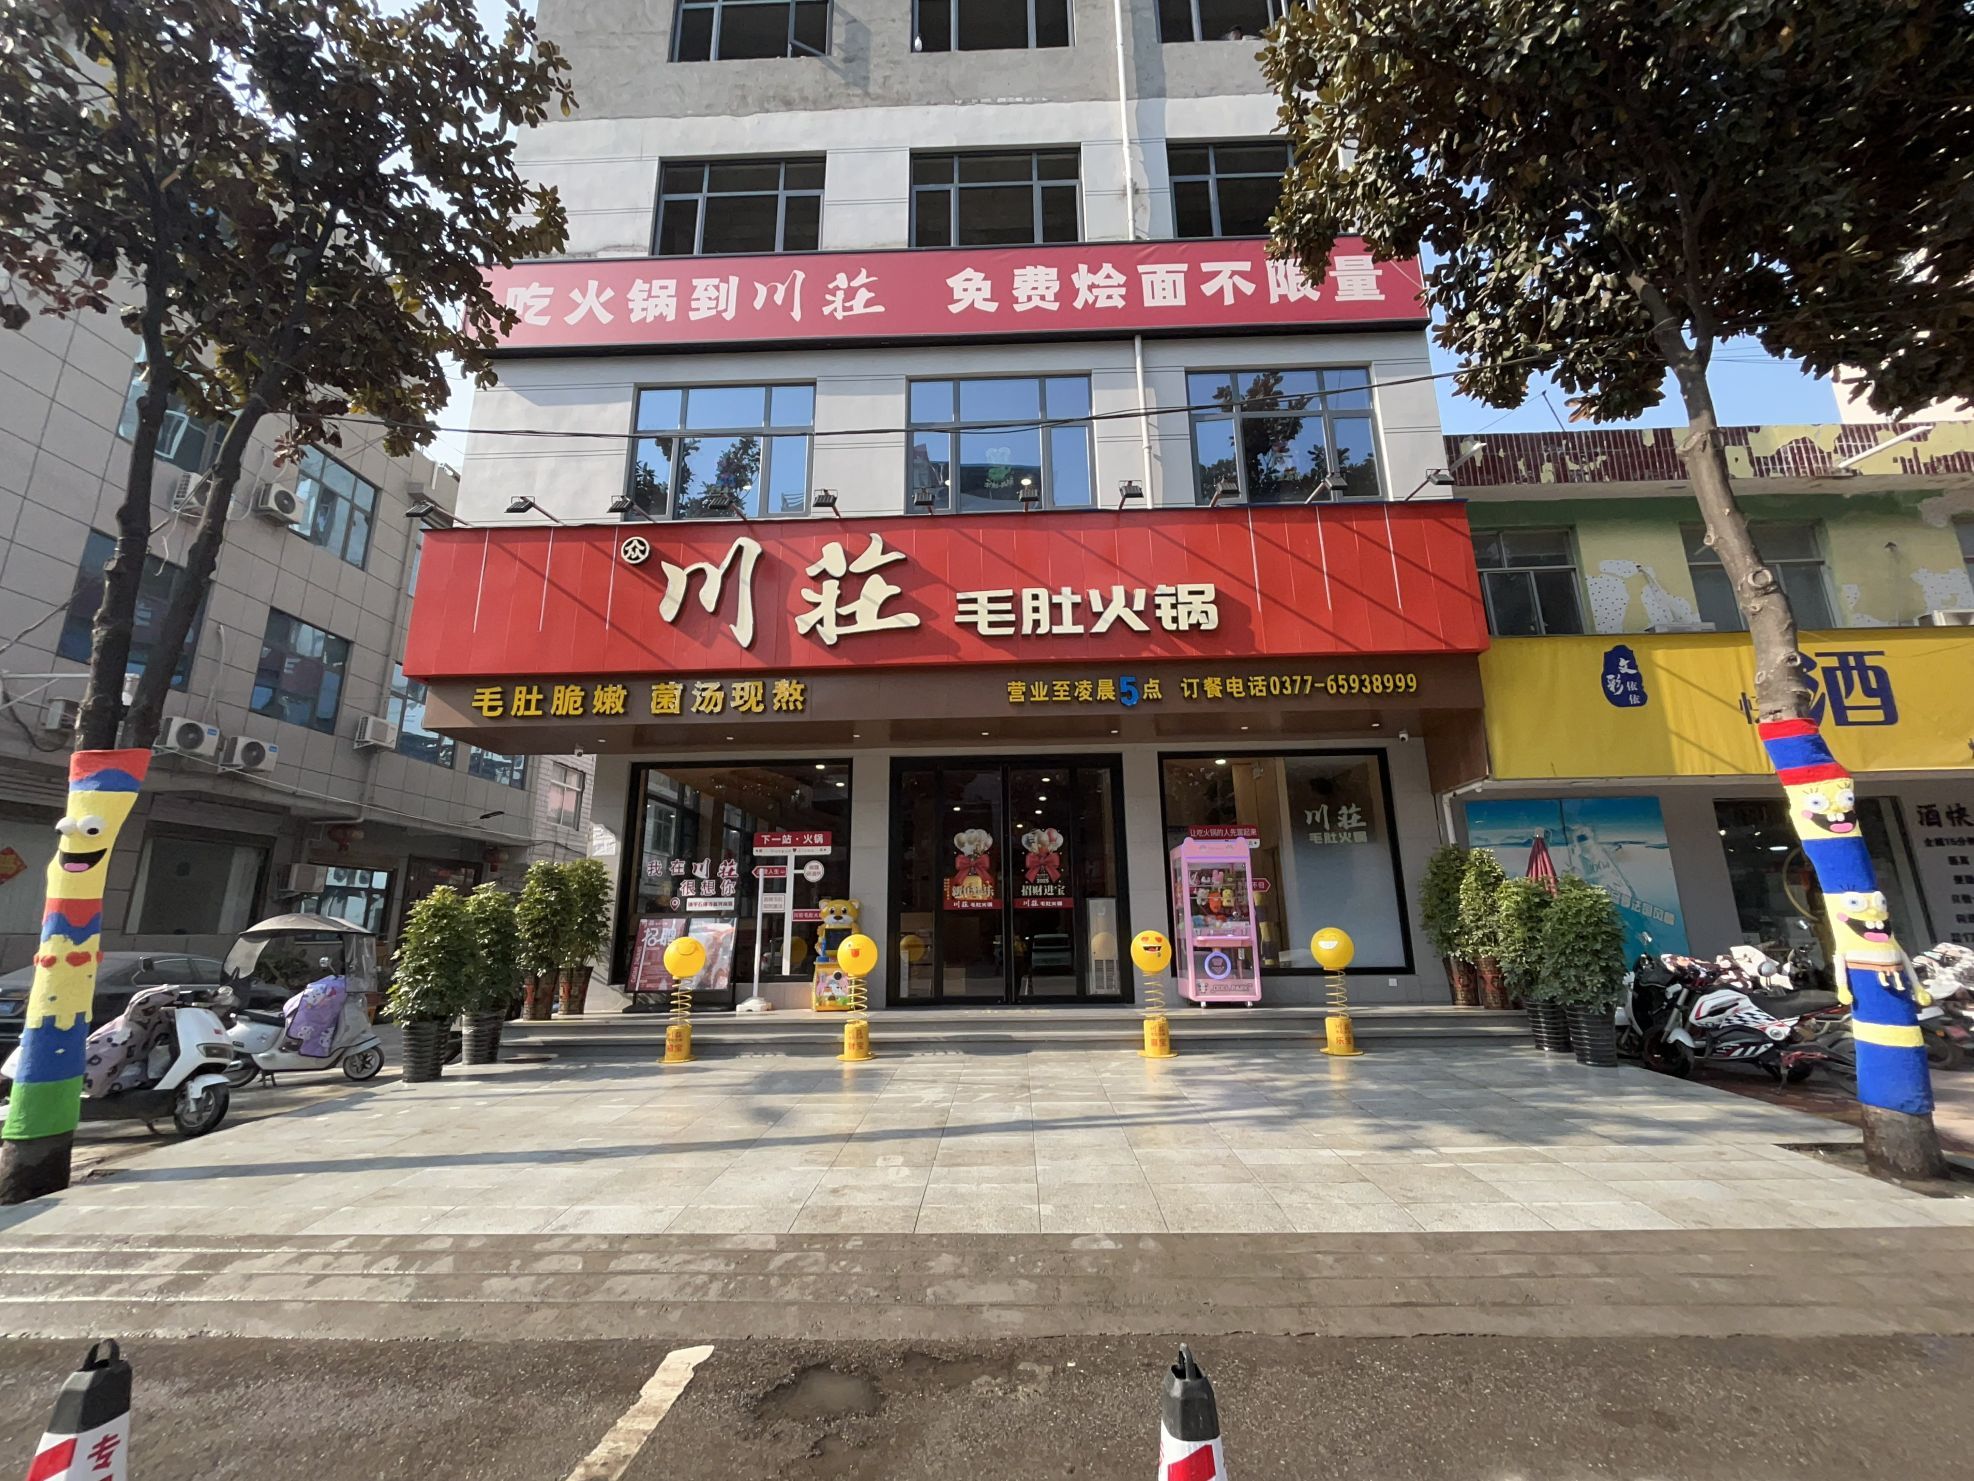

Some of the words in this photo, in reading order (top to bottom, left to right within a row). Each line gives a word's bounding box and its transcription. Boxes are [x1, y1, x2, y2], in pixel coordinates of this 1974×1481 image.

[945, 254, 1386, 314] 免费烩面不限量
[954, 583, 1219, 636] 毛肚火锅
[471, 683, 629, 718] 毛肚脆嫩
[650, 678, 806, 715] 菌汤现熬
[1007, 675, 1163, 707] 营业至凌晨5点
[1181, 673, 1418, 700] 订餐电话0377-65938999
[679, 879, 737, 897] 很想你
